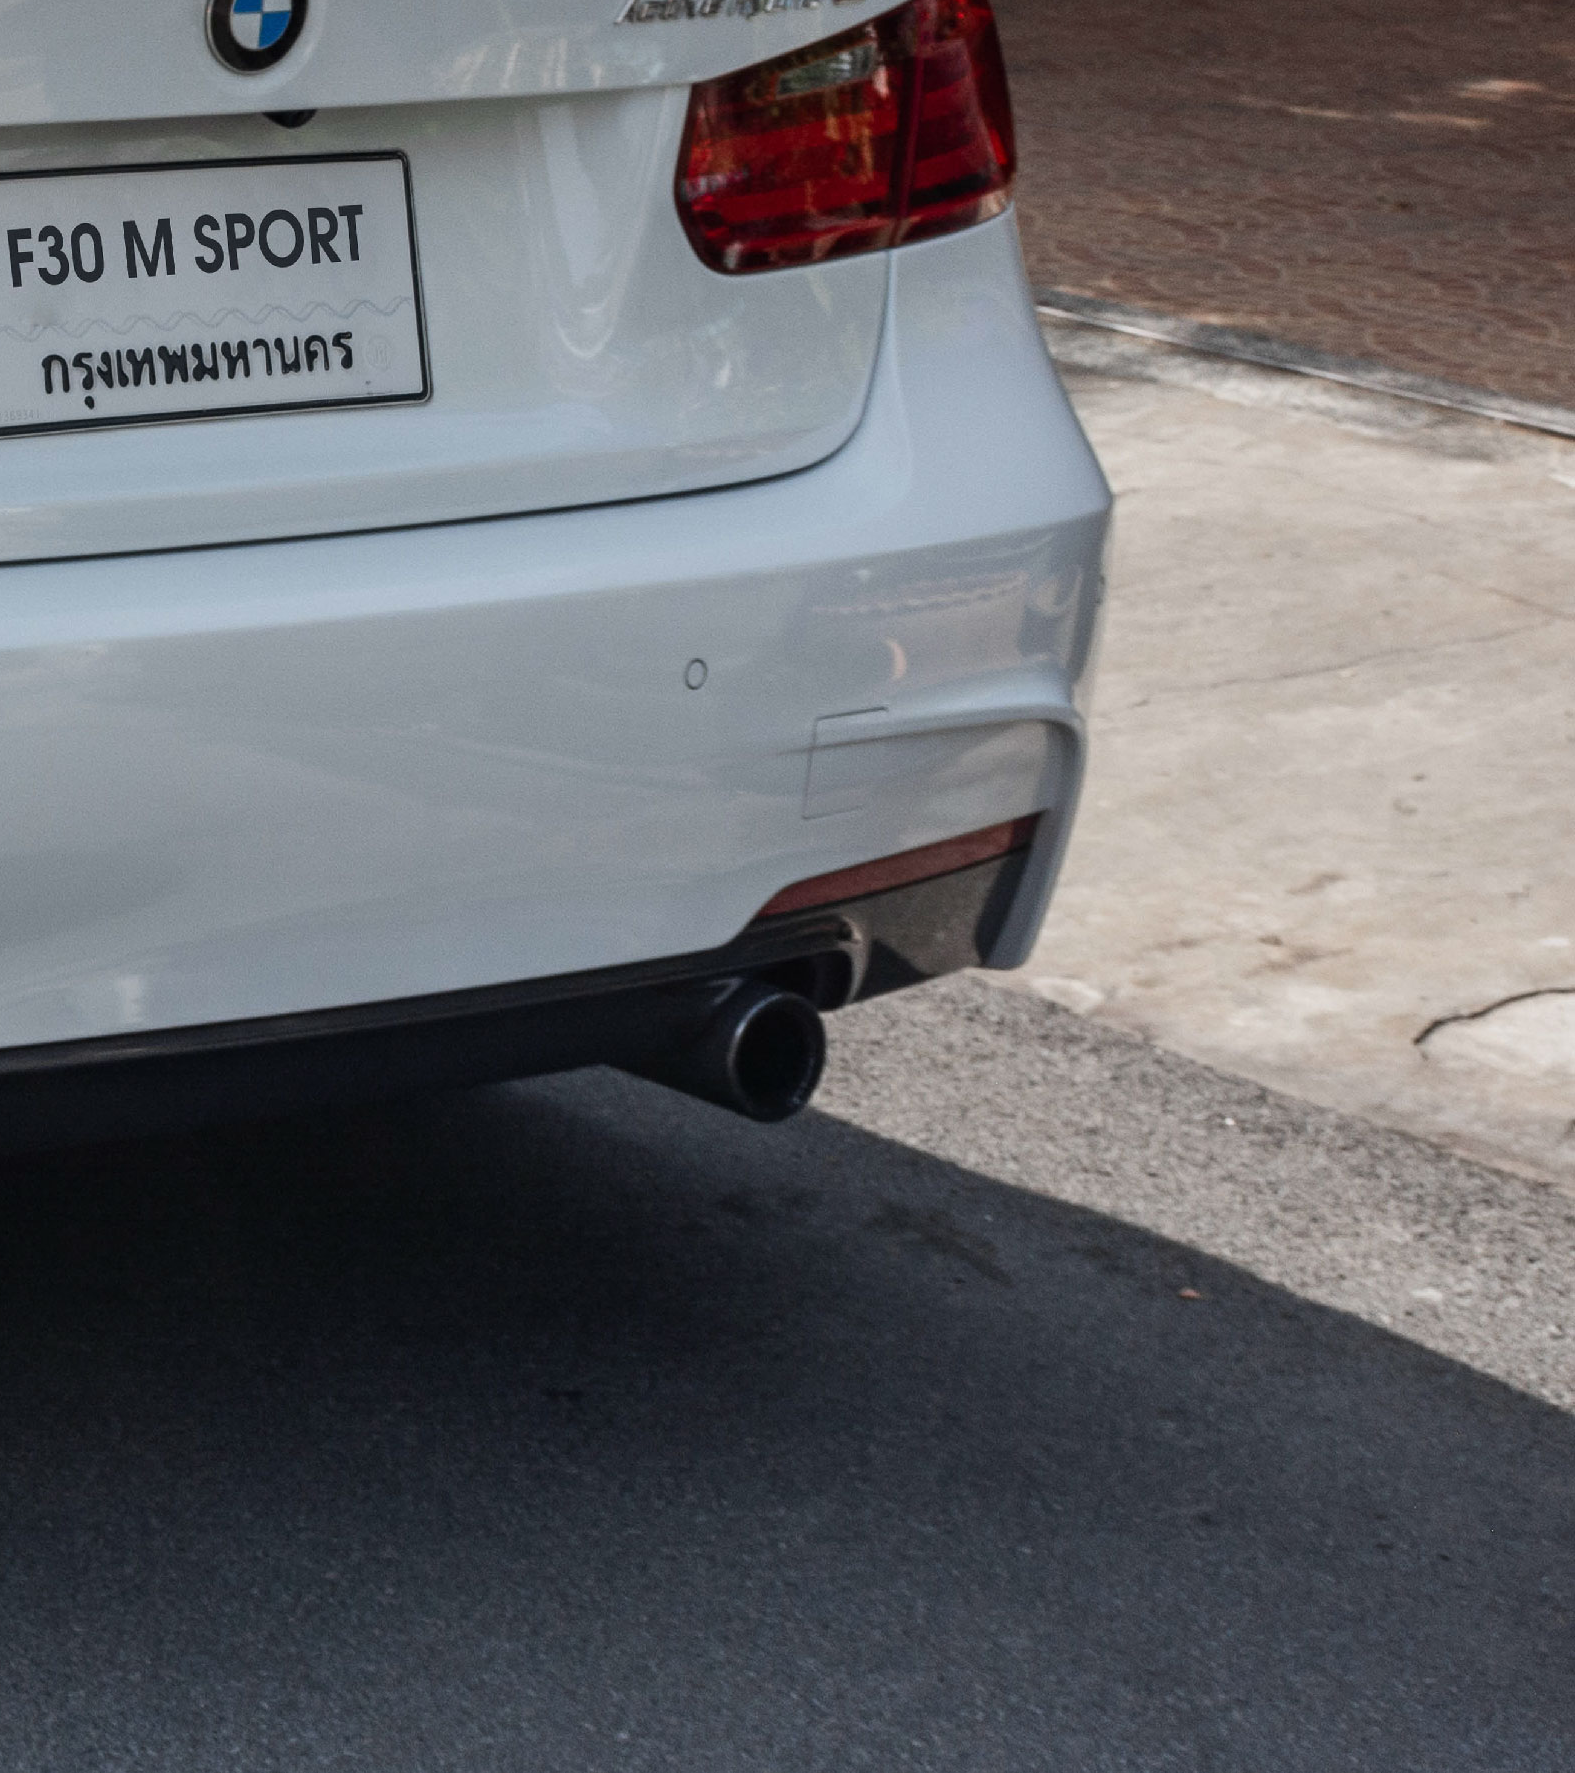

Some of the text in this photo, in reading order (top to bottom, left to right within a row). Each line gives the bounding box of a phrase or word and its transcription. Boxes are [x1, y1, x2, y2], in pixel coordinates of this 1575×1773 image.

[6, 204, 364, 288] F30 M SPORT
[41, 331, 354, 410] กรุงเทพมหานคร
